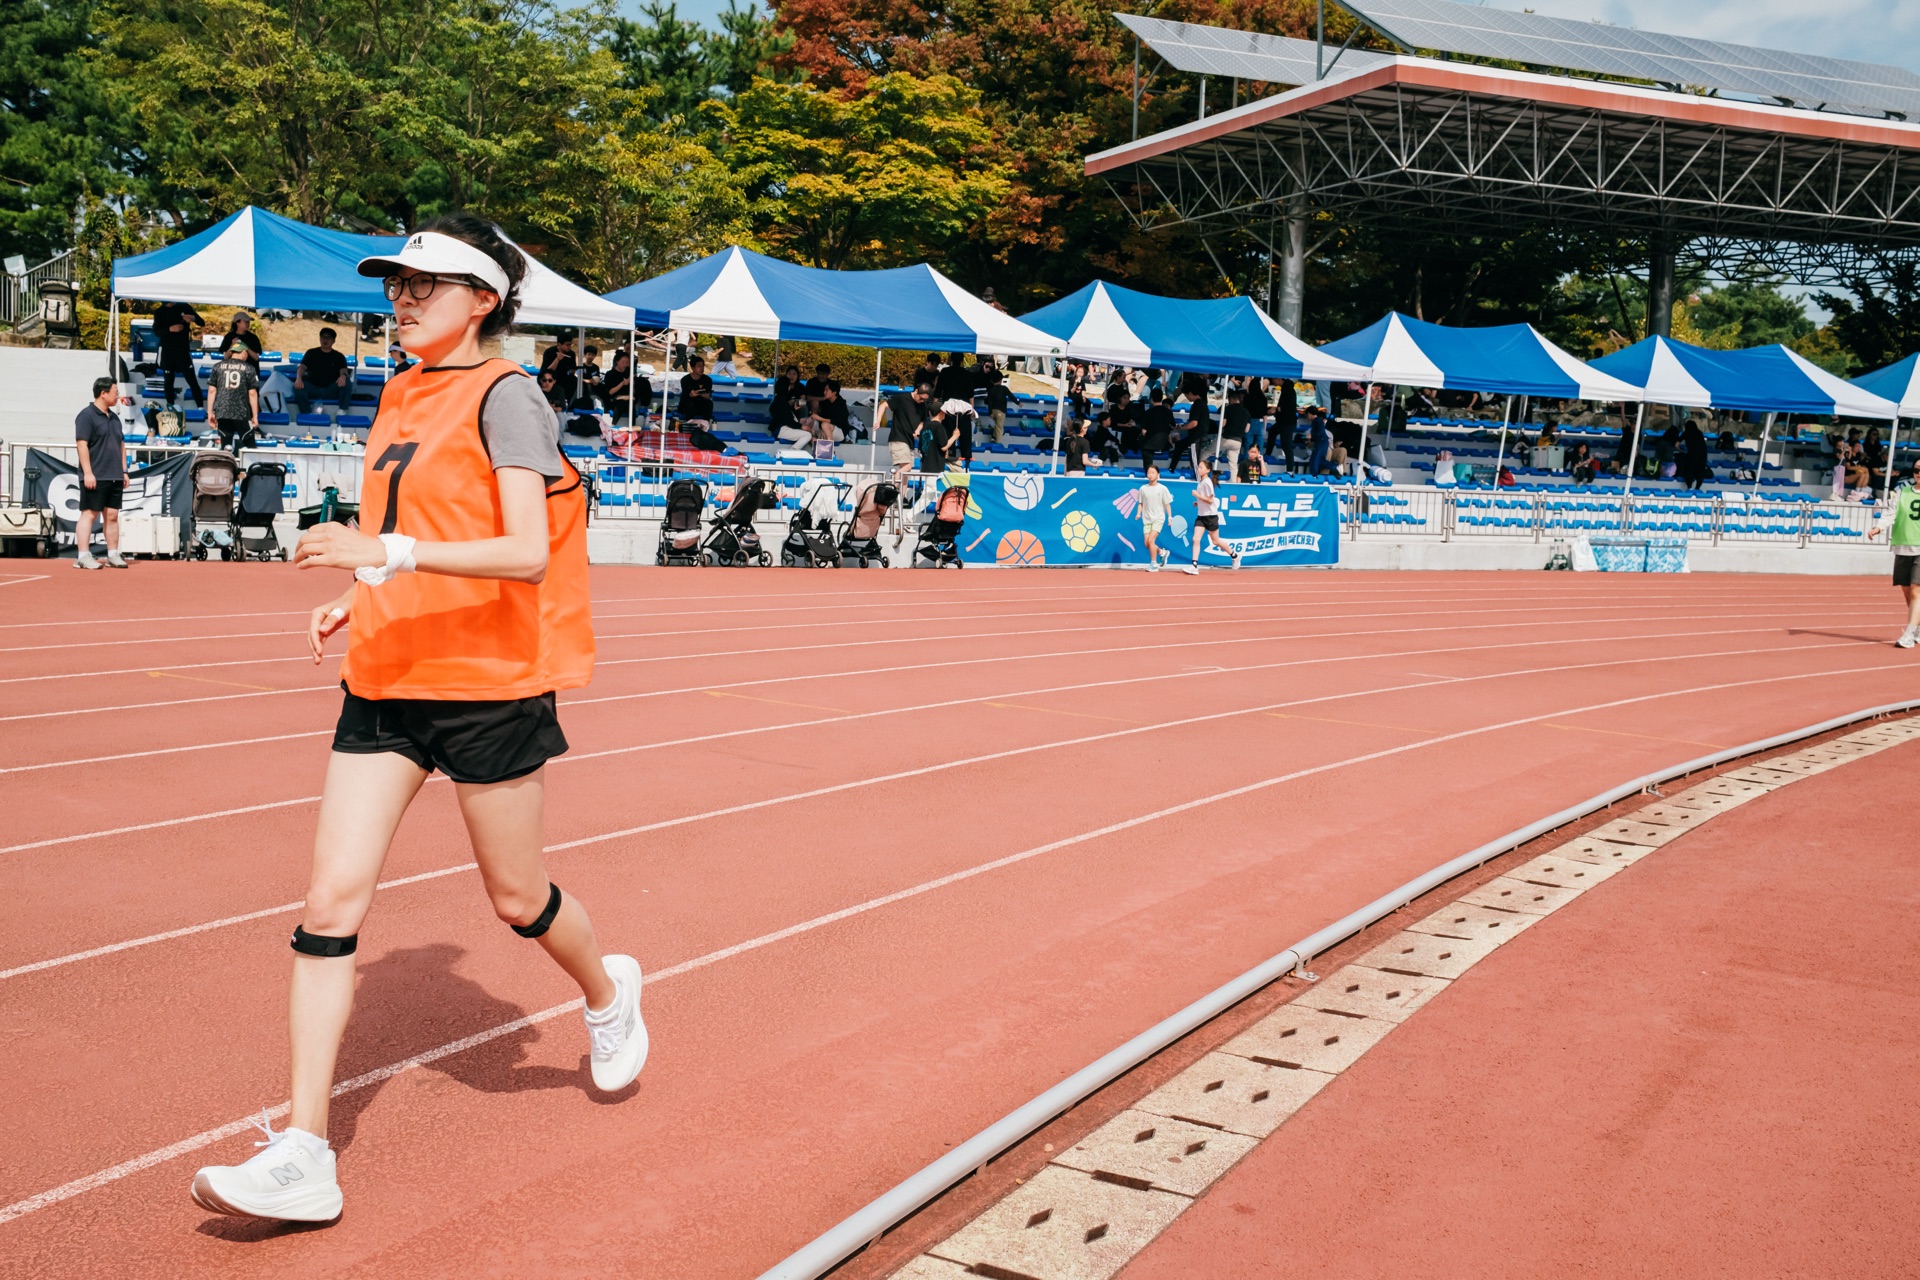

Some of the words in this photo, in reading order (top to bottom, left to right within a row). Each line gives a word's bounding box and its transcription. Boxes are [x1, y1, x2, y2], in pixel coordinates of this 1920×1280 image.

[224, 370, 241, 389] 19
[372, 441, 420, 535] 7
[1909, 499, 1920, 521] 9
[1245, 538, 1275, 552] 전교인
[1277, 534, 1315, 547] 체육대회
[269, 1162, 305, 1187] N
